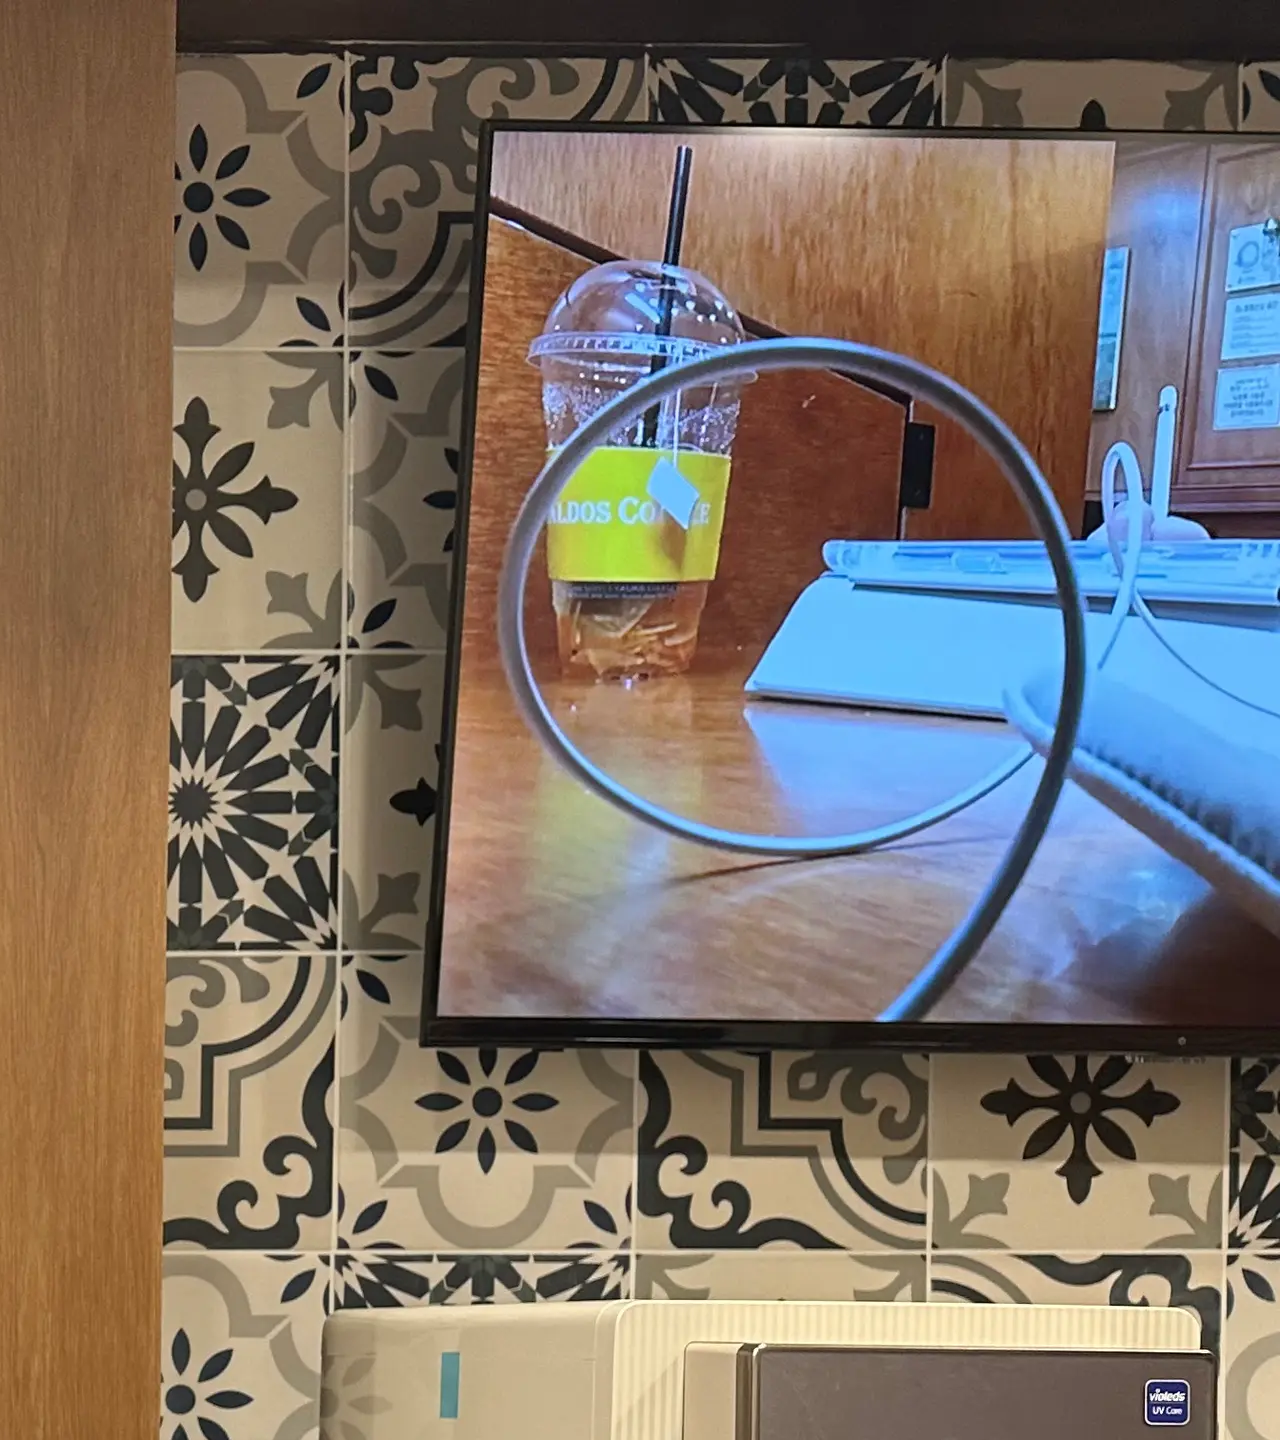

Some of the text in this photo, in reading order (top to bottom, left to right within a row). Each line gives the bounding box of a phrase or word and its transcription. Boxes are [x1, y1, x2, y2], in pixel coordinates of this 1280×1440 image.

[1149, 1388, 1186, 1402] violeds
[1152, 1406, 1183, 1415] UV Care
